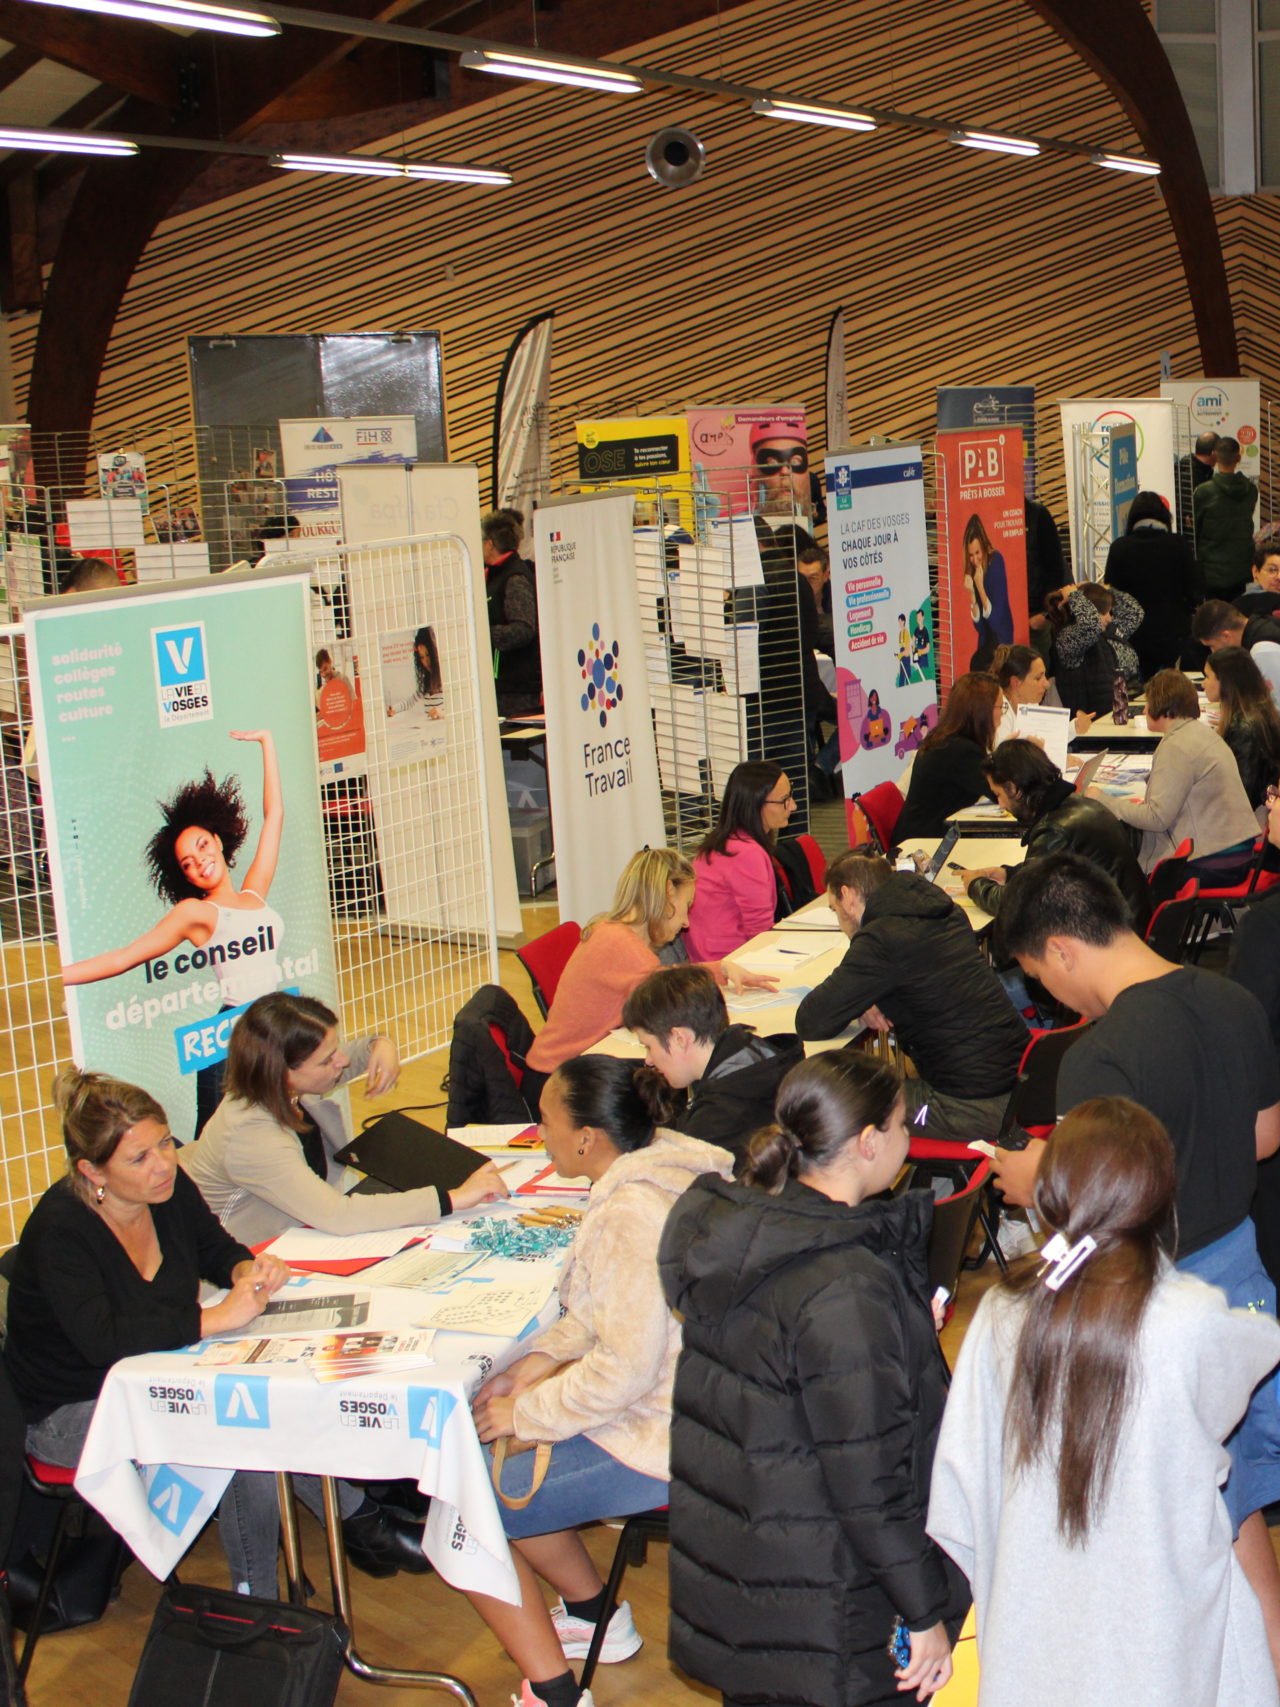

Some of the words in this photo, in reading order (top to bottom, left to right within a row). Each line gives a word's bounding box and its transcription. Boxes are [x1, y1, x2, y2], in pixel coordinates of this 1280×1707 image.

[1196, 394, 1222, 407] ami
[583, 449, 627, 473] OSE
[307, 488, 340, 499] REST
[960, 489, 978, 501] PRÊTS
[978, 487, 984, 499] À
[984, 486, 1006, 498] BOSSER
[840, 523, 850, 535] LA
[851, 520, 866, 534] CAF
[866, 517, 881, 531] DES
[883, 513, 911, 528] VOSGES
[841, 536, 871, 553] CHAQUE
[873, 532, 892, 547] JOUR
[893, 530, 899, 543] À
[842, 557, 858, 569] VOS
[859, 552, 883, 567] CÔTÉS
[52, 641, 123, 666] solidarité
[54, 665, 117, 685] collèges
[56, 686, 106, 704] routes
[175, 684, 194, 698] VIE
[58, 704, 113, 723] culture
[162, 695, 209, 714] VOSGES
[583, 736, 631, 769] France
[585, 758, 634, 799] Travail
[144, 960, 169, 984] le
[174, 925, 276, 975] conseil
[149, 1385, 206, 1402] VOSGES
[168, 1401, 190, 1415] VIE
[339, 1400, 398, 1416] VOSGES
[358, 1415, 382, 1429] VIE
